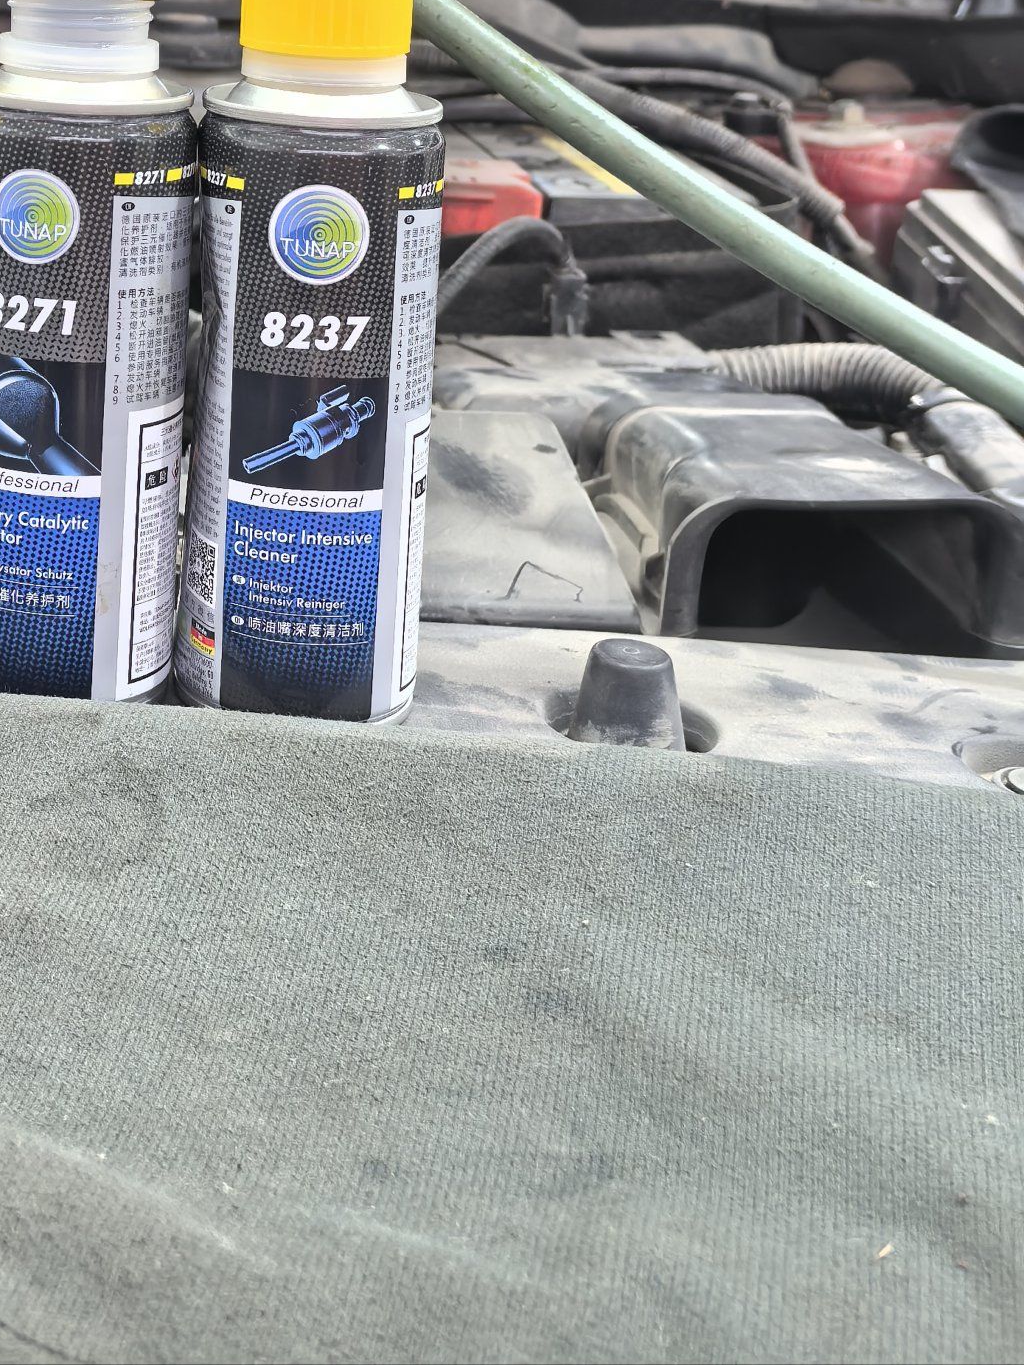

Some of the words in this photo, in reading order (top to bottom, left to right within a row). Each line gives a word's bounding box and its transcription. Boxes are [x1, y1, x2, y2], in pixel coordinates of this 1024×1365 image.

[135, 169, 164, 186] 8271
[415, 180, 436, 198] 8237
[0, 218, 66, 241] TUNAP
[280, 238, 355, 259] TUNAP
[260, 311, 372, 351] 8237
[250, 487, 364, 508] Professional
[18, 511, 89, 534] Catalytic
[234, 520, 297, 544] Injector
[301, 529, 373, 546] Intensive
[234, 540, 298, 564] Cleaner
[35, 567, 74, 581] Schutz
[249, 577, 294, 594] Injektor
[248, 591, 294, 608] Intensiv
[296, 597, 346, 612] Reiniger
[247, 616, 365, 638] 喷油嘴深度清洁剂
